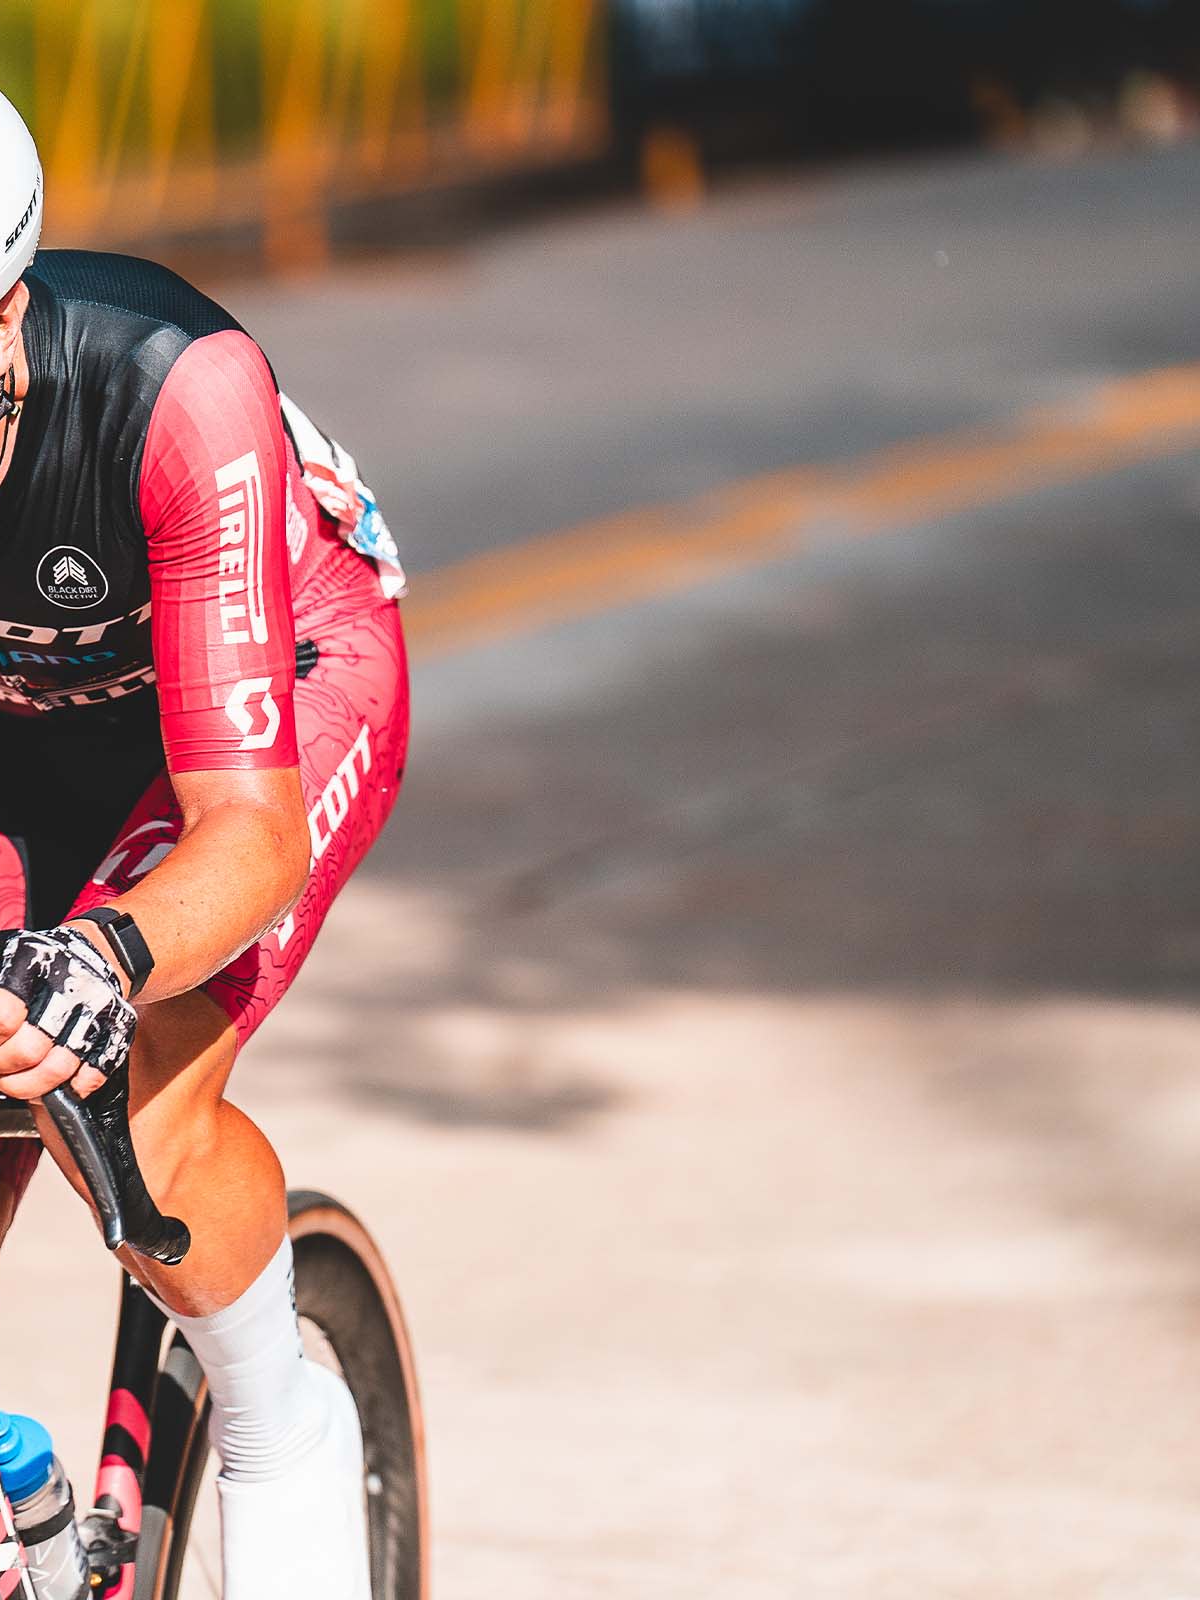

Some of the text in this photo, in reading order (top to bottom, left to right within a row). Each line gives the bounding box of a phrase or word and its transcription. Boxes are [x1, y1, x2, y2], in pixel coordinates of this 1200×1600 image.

[4, 188, 37, 254] SCOTT
[47, 585, 98, 594] BLACK DIRT
[214, 450, 269, 645] PIRELLI
[308, 723, 371, 872] COTT
